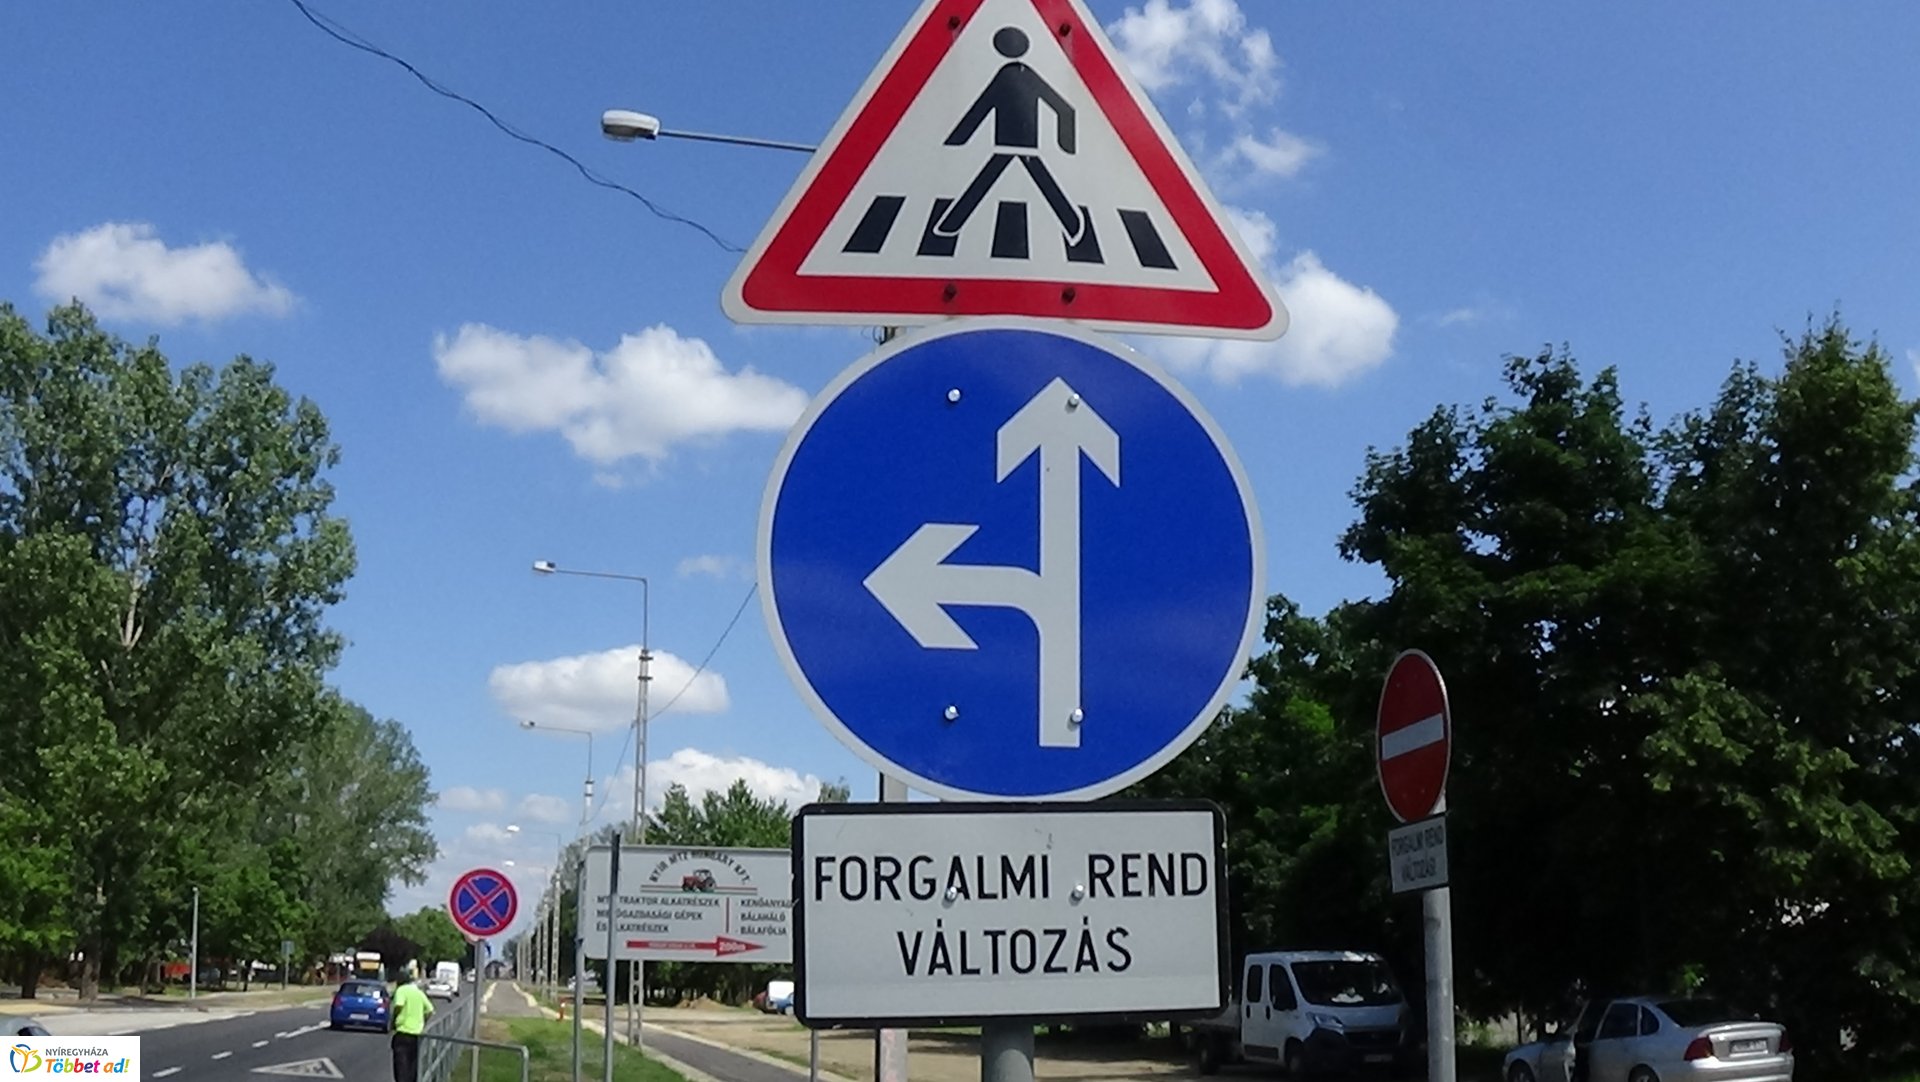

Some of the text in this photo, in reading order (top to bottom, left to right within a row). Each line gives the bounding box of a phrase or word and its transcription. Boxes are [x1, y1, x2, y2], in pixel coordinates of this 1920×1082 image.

[814, 852, 1208, 901] FORGALMI REND
[619, 896, 658, 905] TRAKTOR
[660, 897, 720, 907] ALKATRÉSZEK
[674, 910, 703, 920] GÉPEK
[613, 922, 669, 933] LKATRÉSZEK
[897, 916, 1132, 976] VÁLTOZÁS
